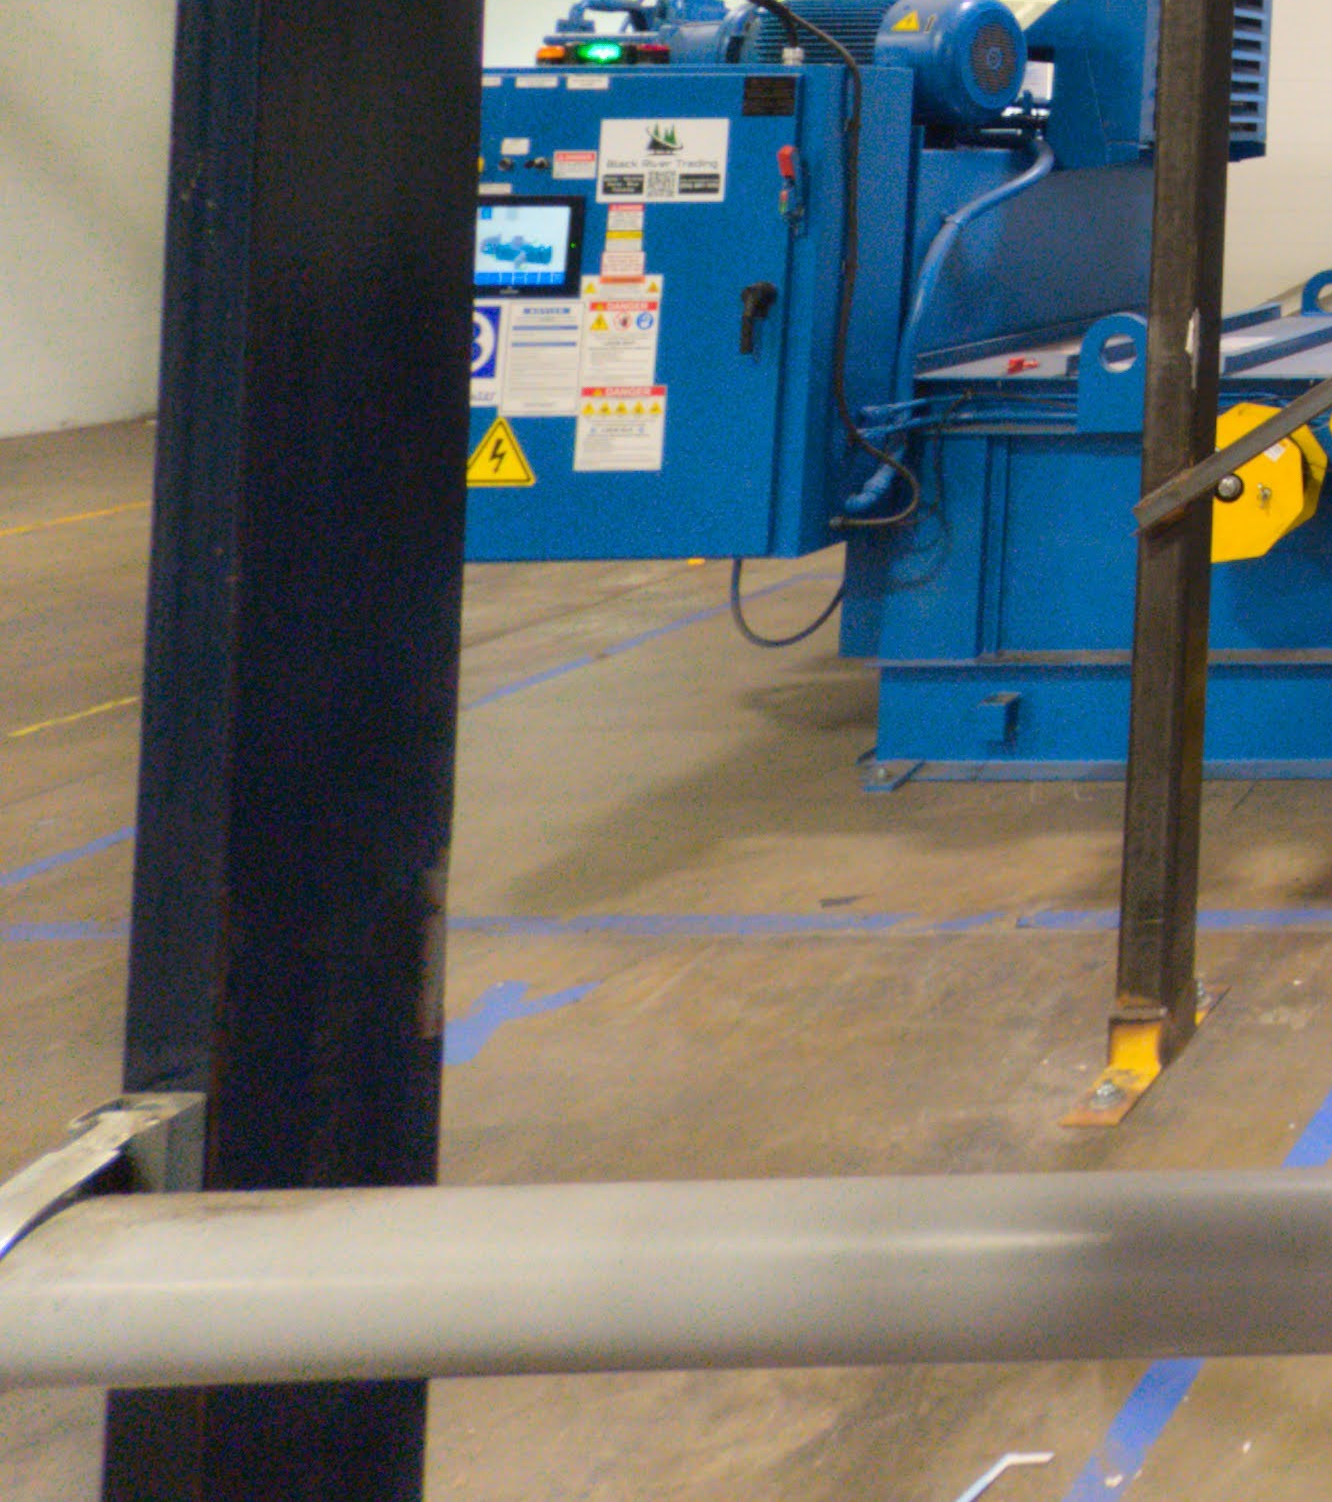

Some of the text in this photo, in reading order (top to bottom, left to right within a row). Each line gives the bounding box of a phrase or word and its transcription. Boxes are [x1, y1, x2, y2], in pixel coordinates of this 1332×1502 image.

[606, 159, 718, 170] Black River Trading
